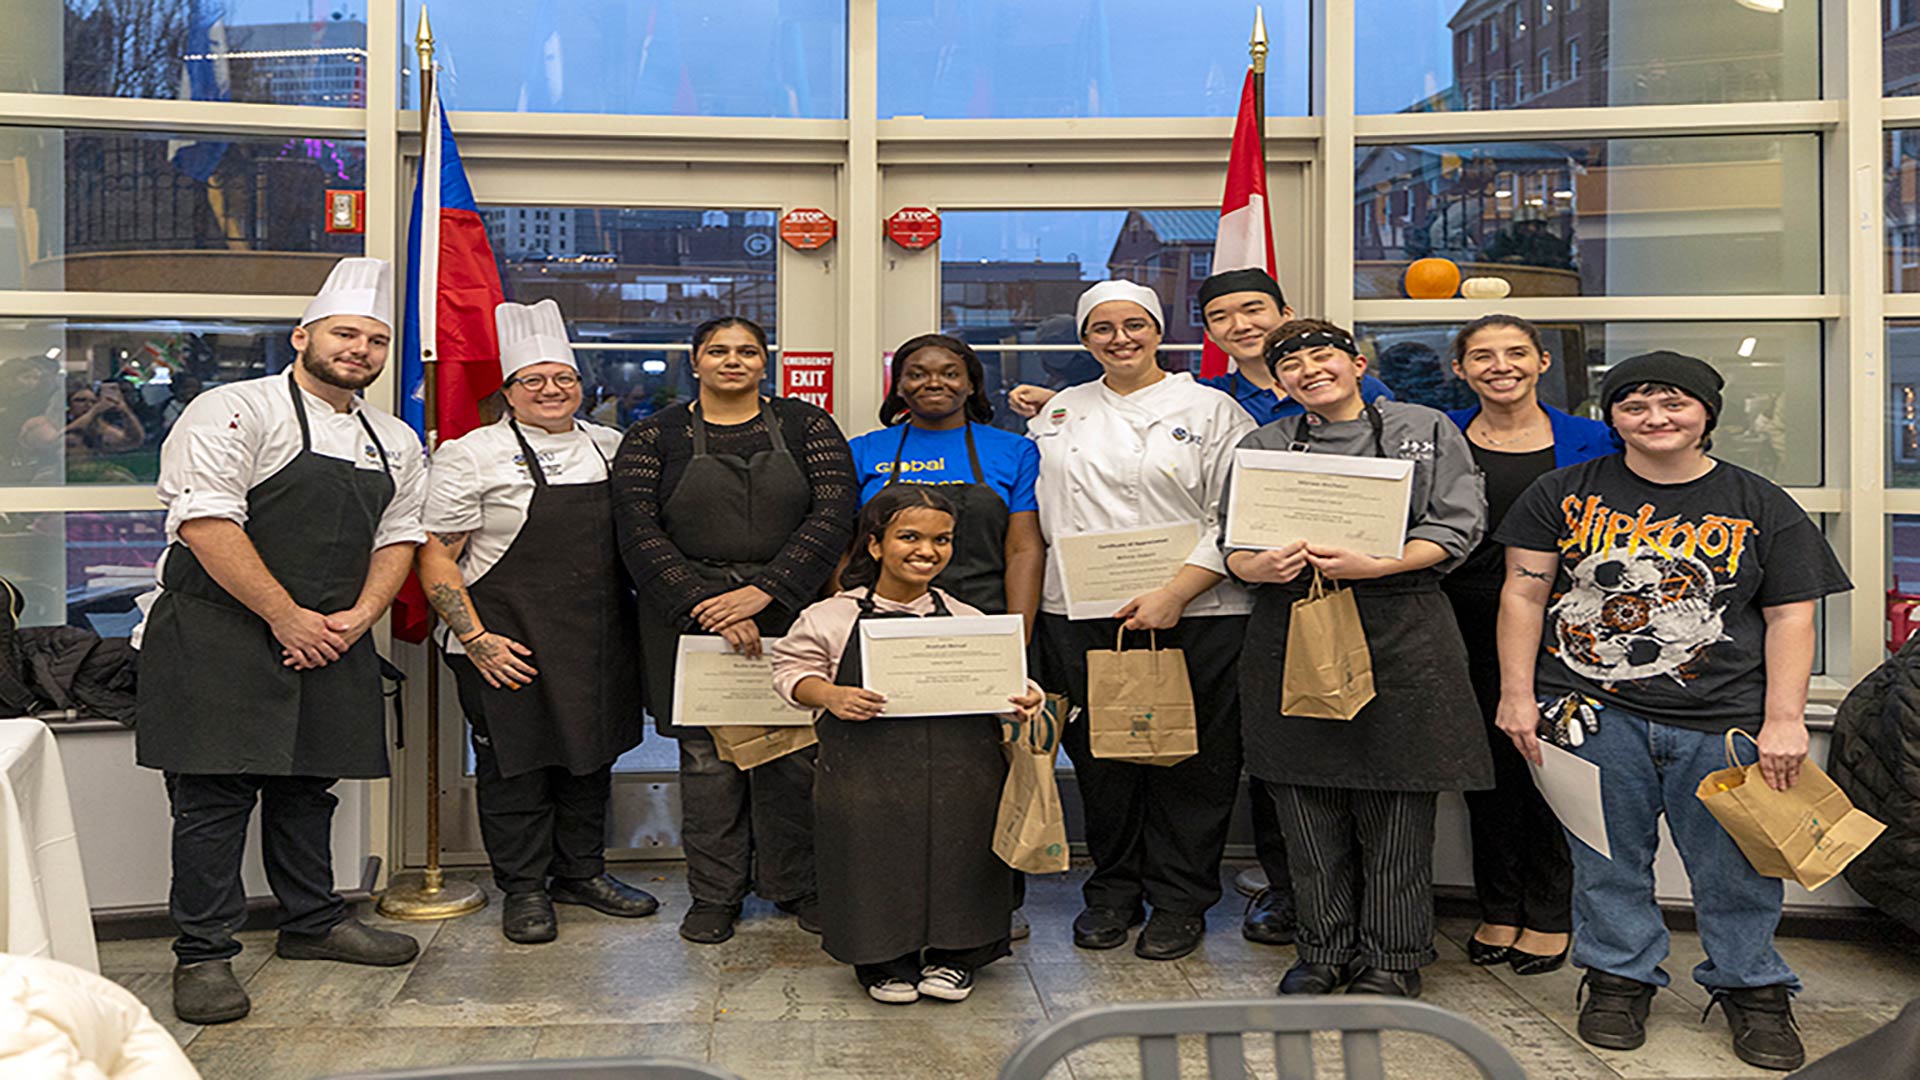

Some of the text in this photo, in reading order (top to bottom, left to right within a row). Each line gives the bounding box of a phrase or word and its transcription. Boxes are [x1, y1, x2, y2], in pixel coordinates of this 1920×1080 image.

[789, 212, 824, 221] STOP
[898, 211, 933, 220] STOP
[791, 370, 826, 387] EXIT
